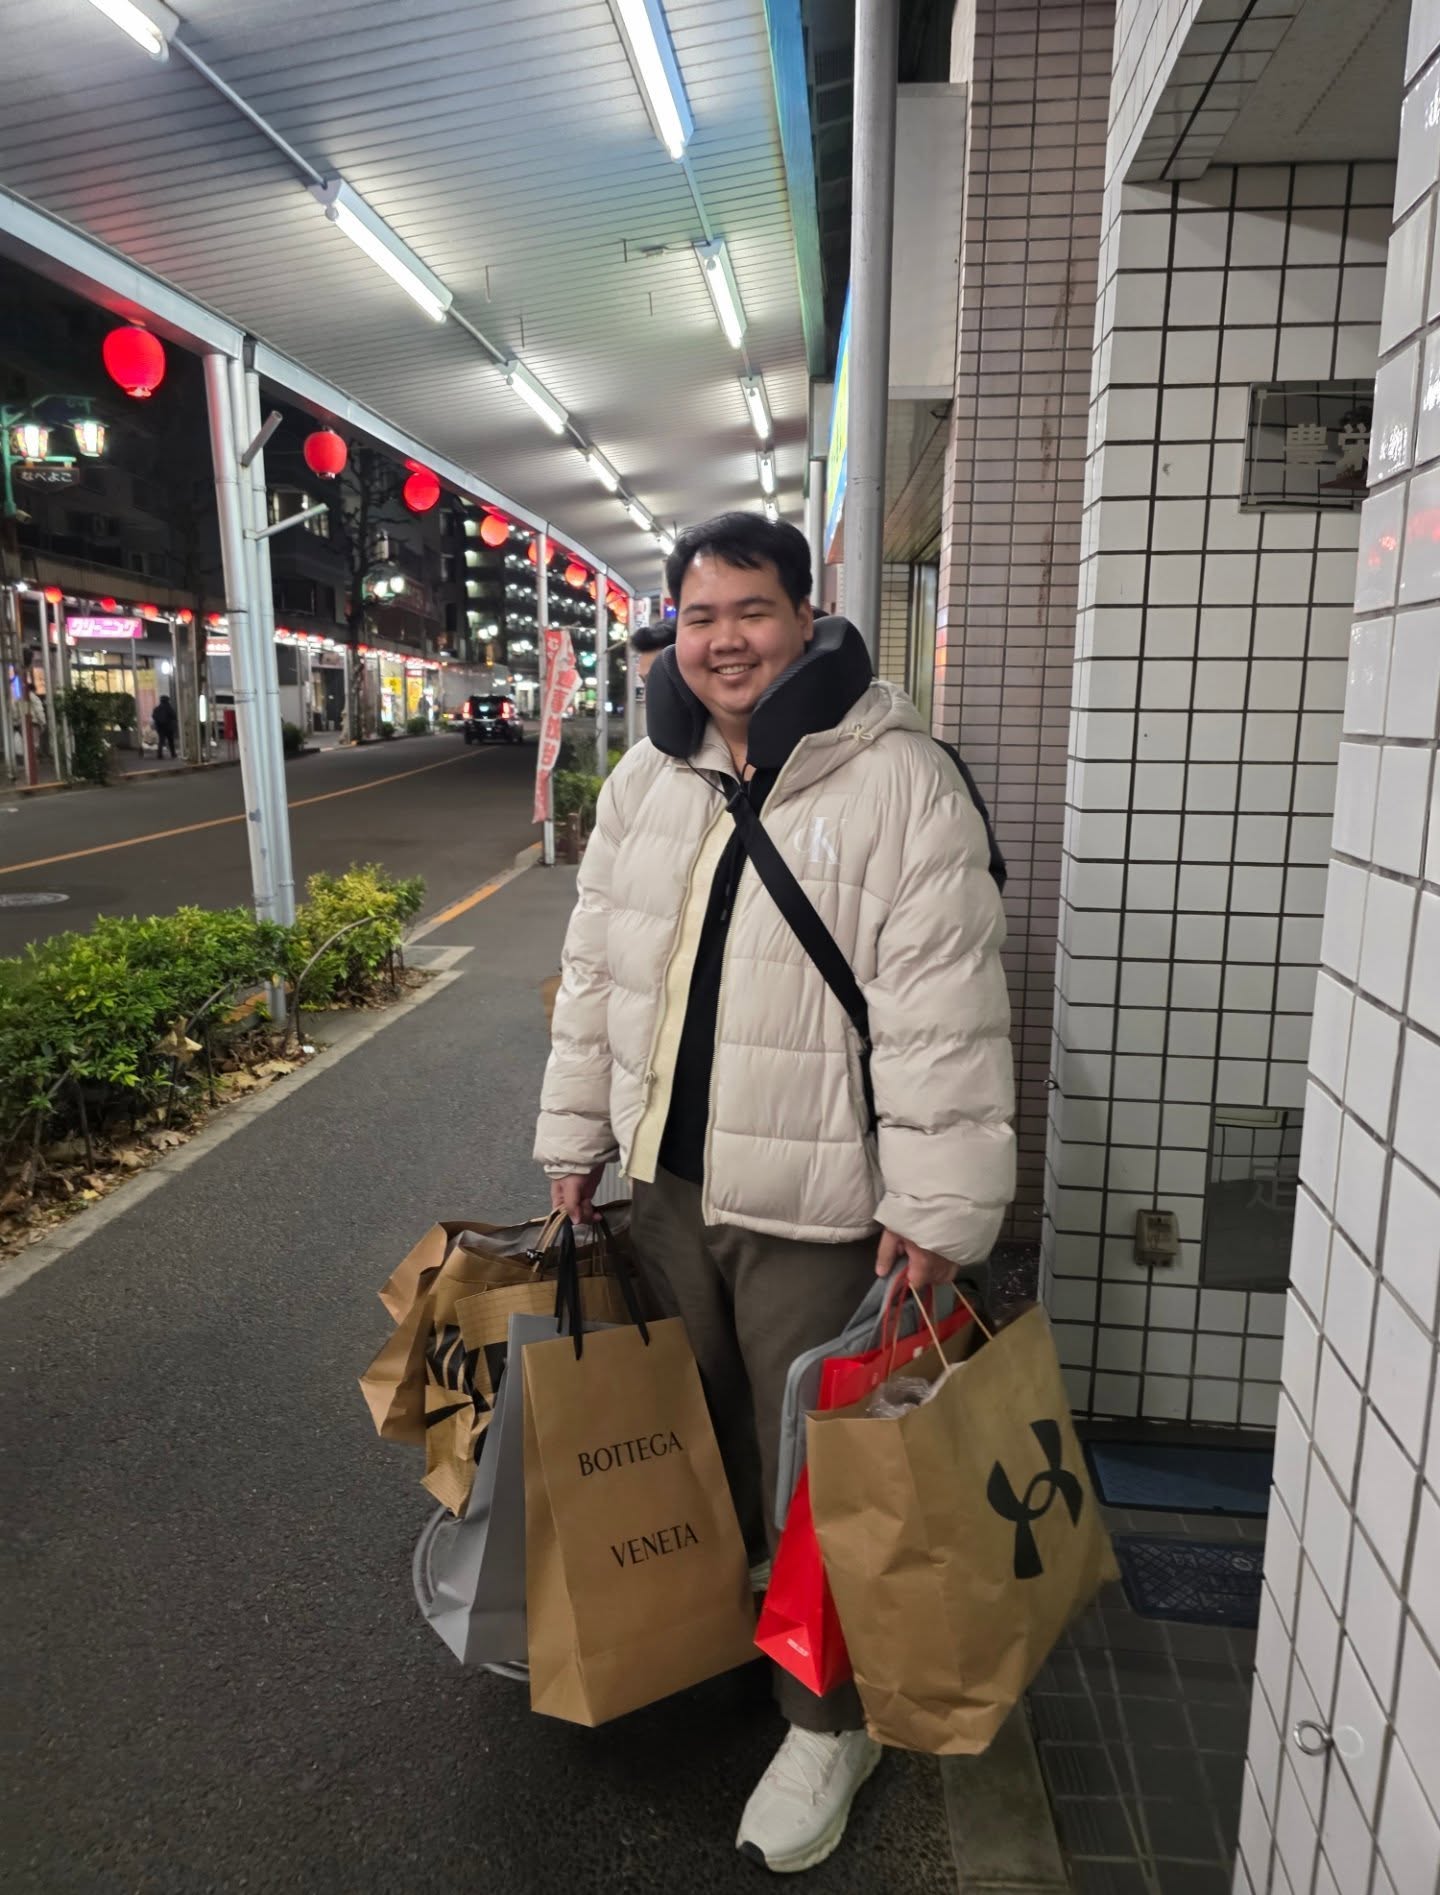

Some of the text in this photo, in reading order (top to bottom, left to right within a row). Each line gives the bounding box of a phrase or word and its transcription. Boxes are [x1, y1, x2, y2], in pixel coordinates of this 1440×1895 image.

[21, 471, 73, 483] なべよこ
[69, 618, 139, 636] クリーニング
[578, 1431, 684, 1477] BOTTEGA
[610, 1521, 699, 1568] VENETA
